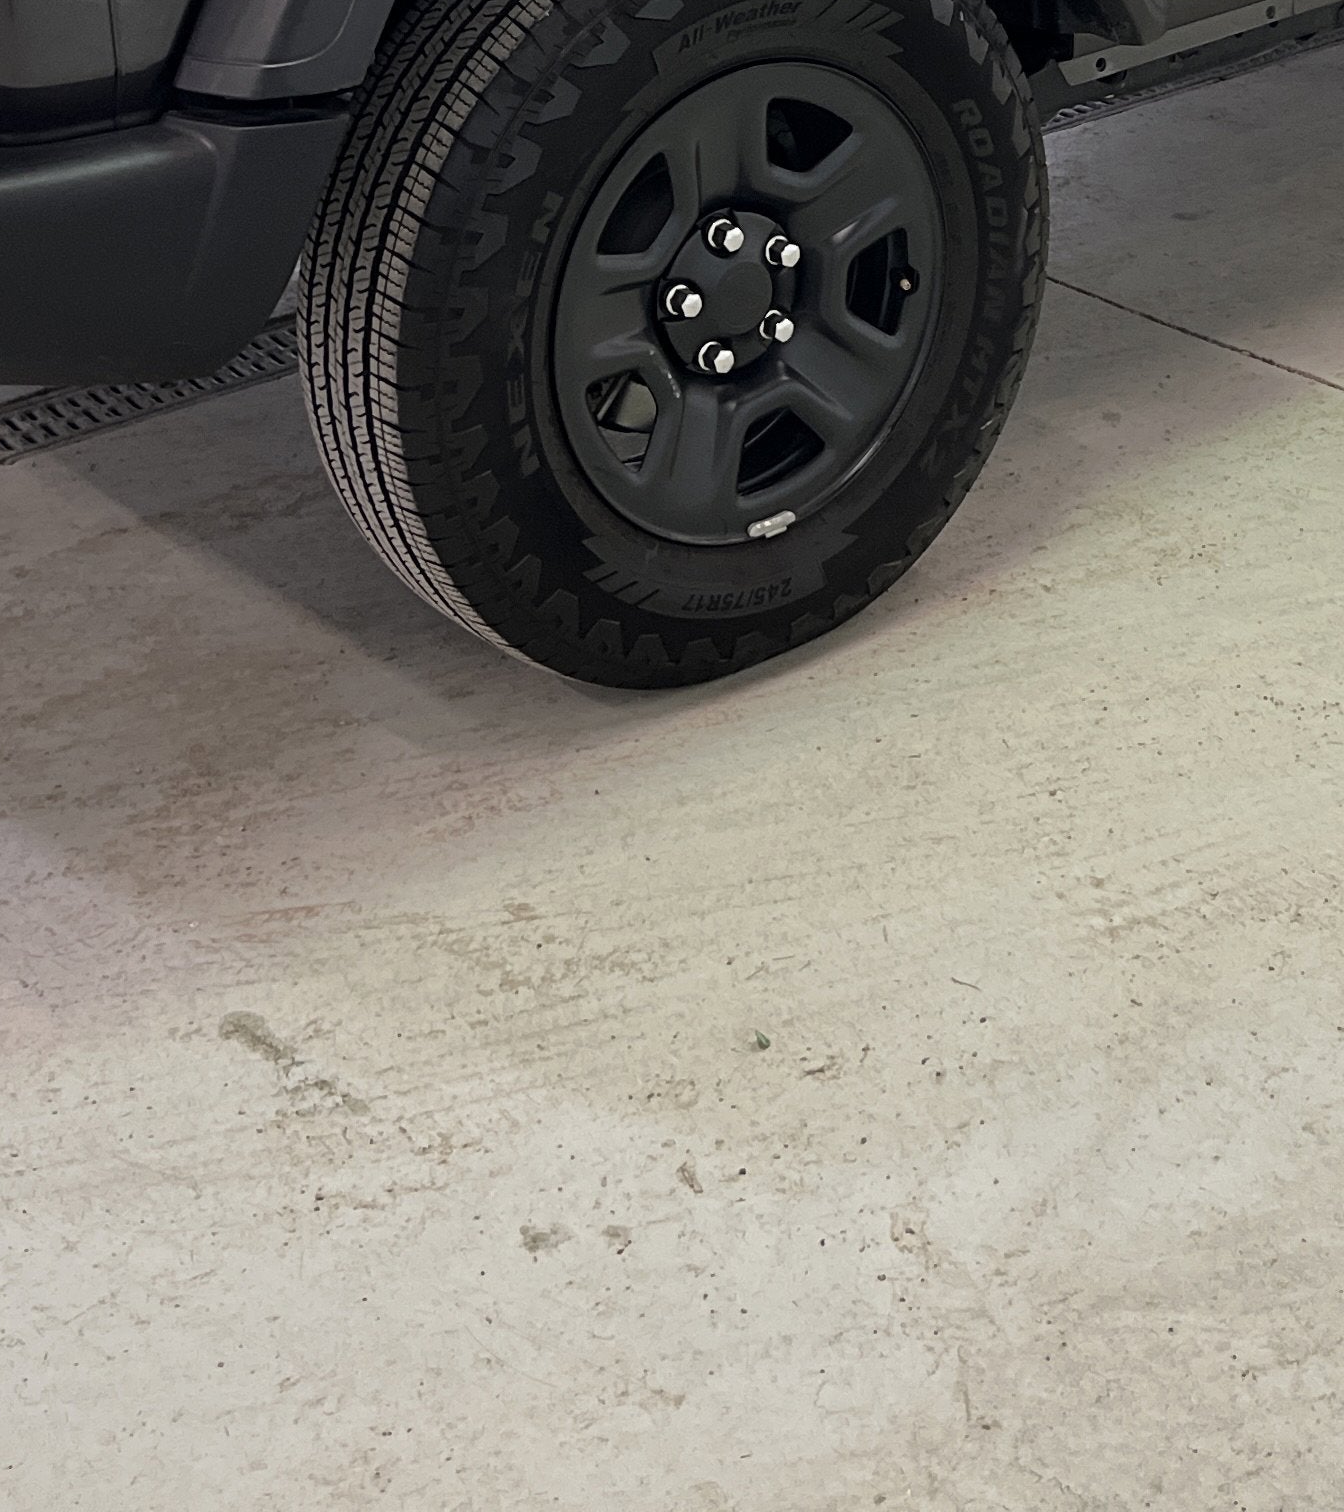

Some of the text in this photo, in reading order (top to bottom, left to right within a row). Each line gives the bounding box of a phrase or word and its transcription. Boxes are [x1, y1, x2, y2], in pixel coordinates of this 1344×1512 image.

[677, 0, 803, 54] All-Weather
[950, 97, 1012, 320] ROADIAN
[504, 190, 564, 479] NEXEN
[681, 577, 793, 613] 245/75R17
